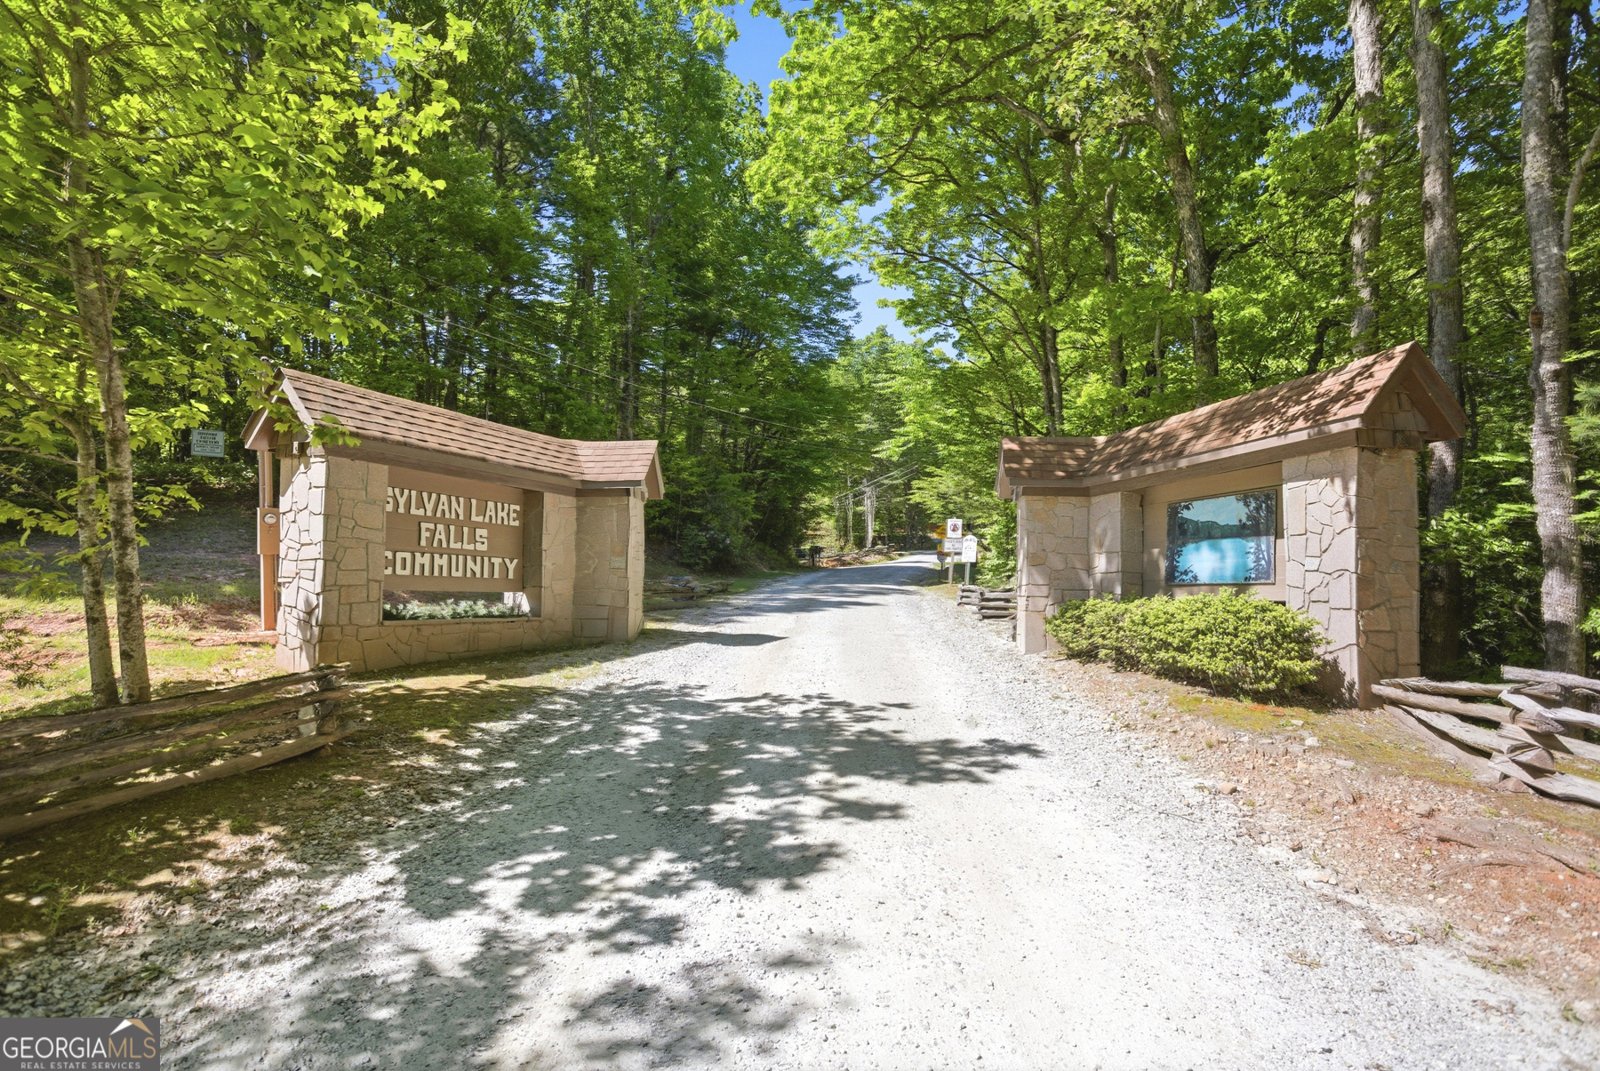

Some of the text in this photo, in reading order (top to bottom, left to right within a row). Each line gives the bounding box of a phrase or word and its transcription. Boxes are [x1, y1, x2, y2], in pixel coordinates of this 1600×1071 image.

[385, 486, 520, 527] SYLVAN LAKE
[419, 521, 488, 551] FALLS
[384, 550, 519, 579] COMMUNITY
